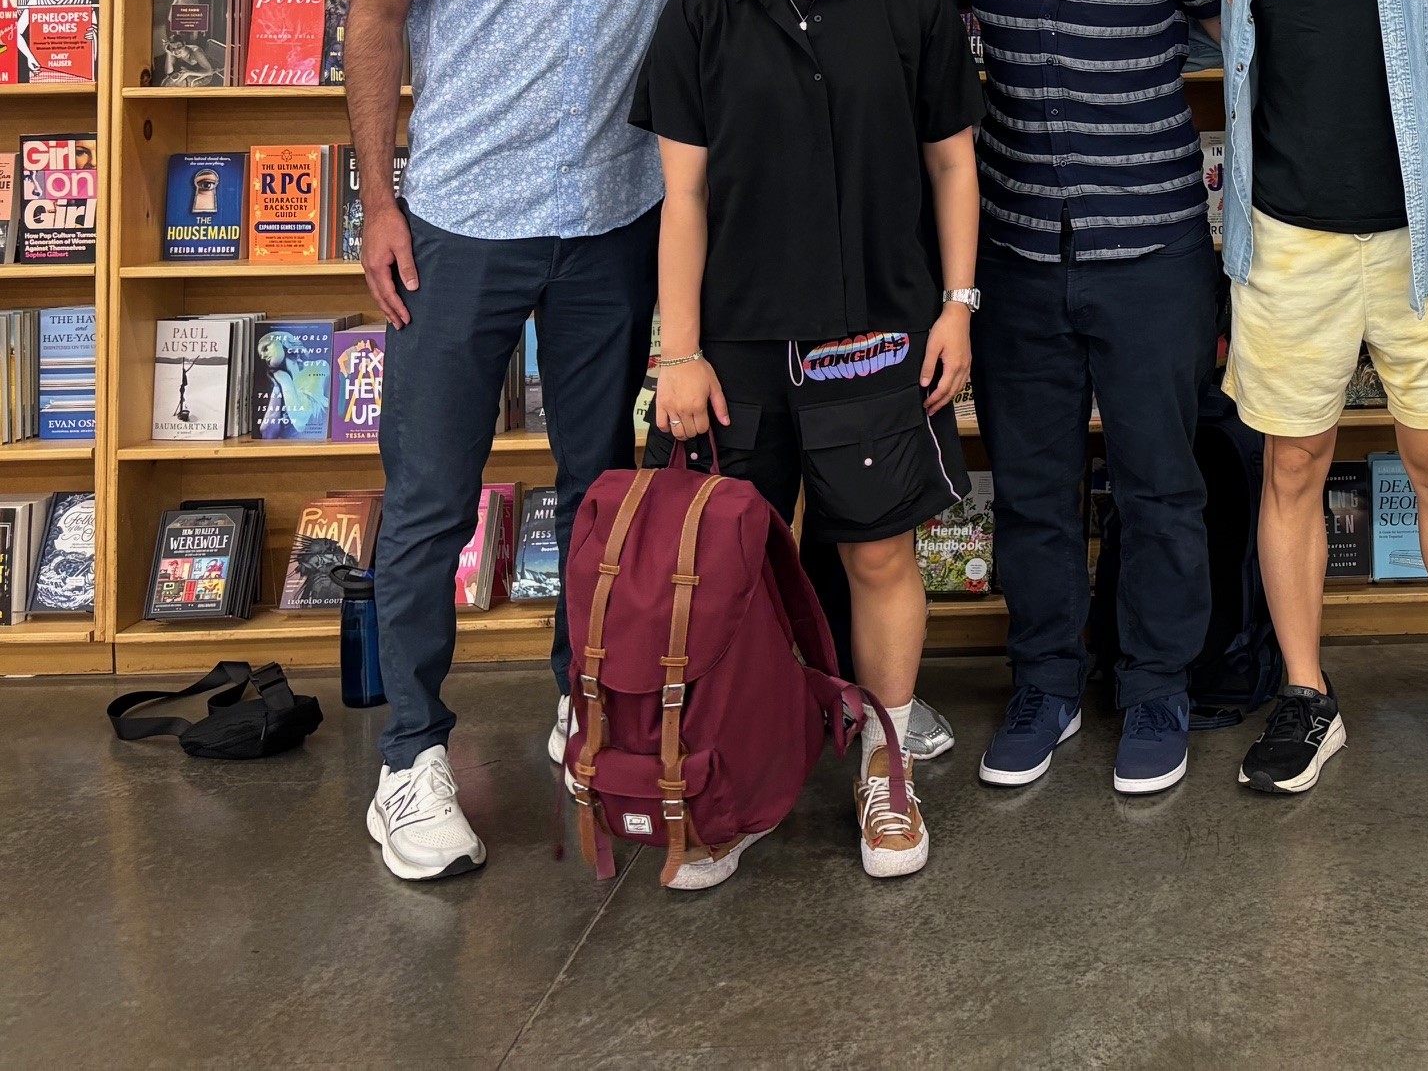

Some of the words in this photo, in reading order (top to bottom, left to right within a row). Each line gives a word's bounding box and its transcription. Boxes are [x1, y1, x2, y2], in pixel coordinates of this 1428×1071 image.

[32, 13, 88, 23] PENELOPE'S
[42, 23, 77, 33] BONES
[24, 142, 75, 170] Girl
[46, 173, 94, 198] on
[261, 173, 313, 195] RPG
[24, 200, 95, 229] Girl
[196, 216, 211, 224] THE
[168, 226, 239, 241] HOUSEMAID
[173, 327, 208, 339] PAUL
[162, 341, 218, 353] AUSTER
[931, 525, 973, 536] Herbal
[170, 535, 229, 550] WEREWOLF
[918, 539, 982, 550] Handbook
